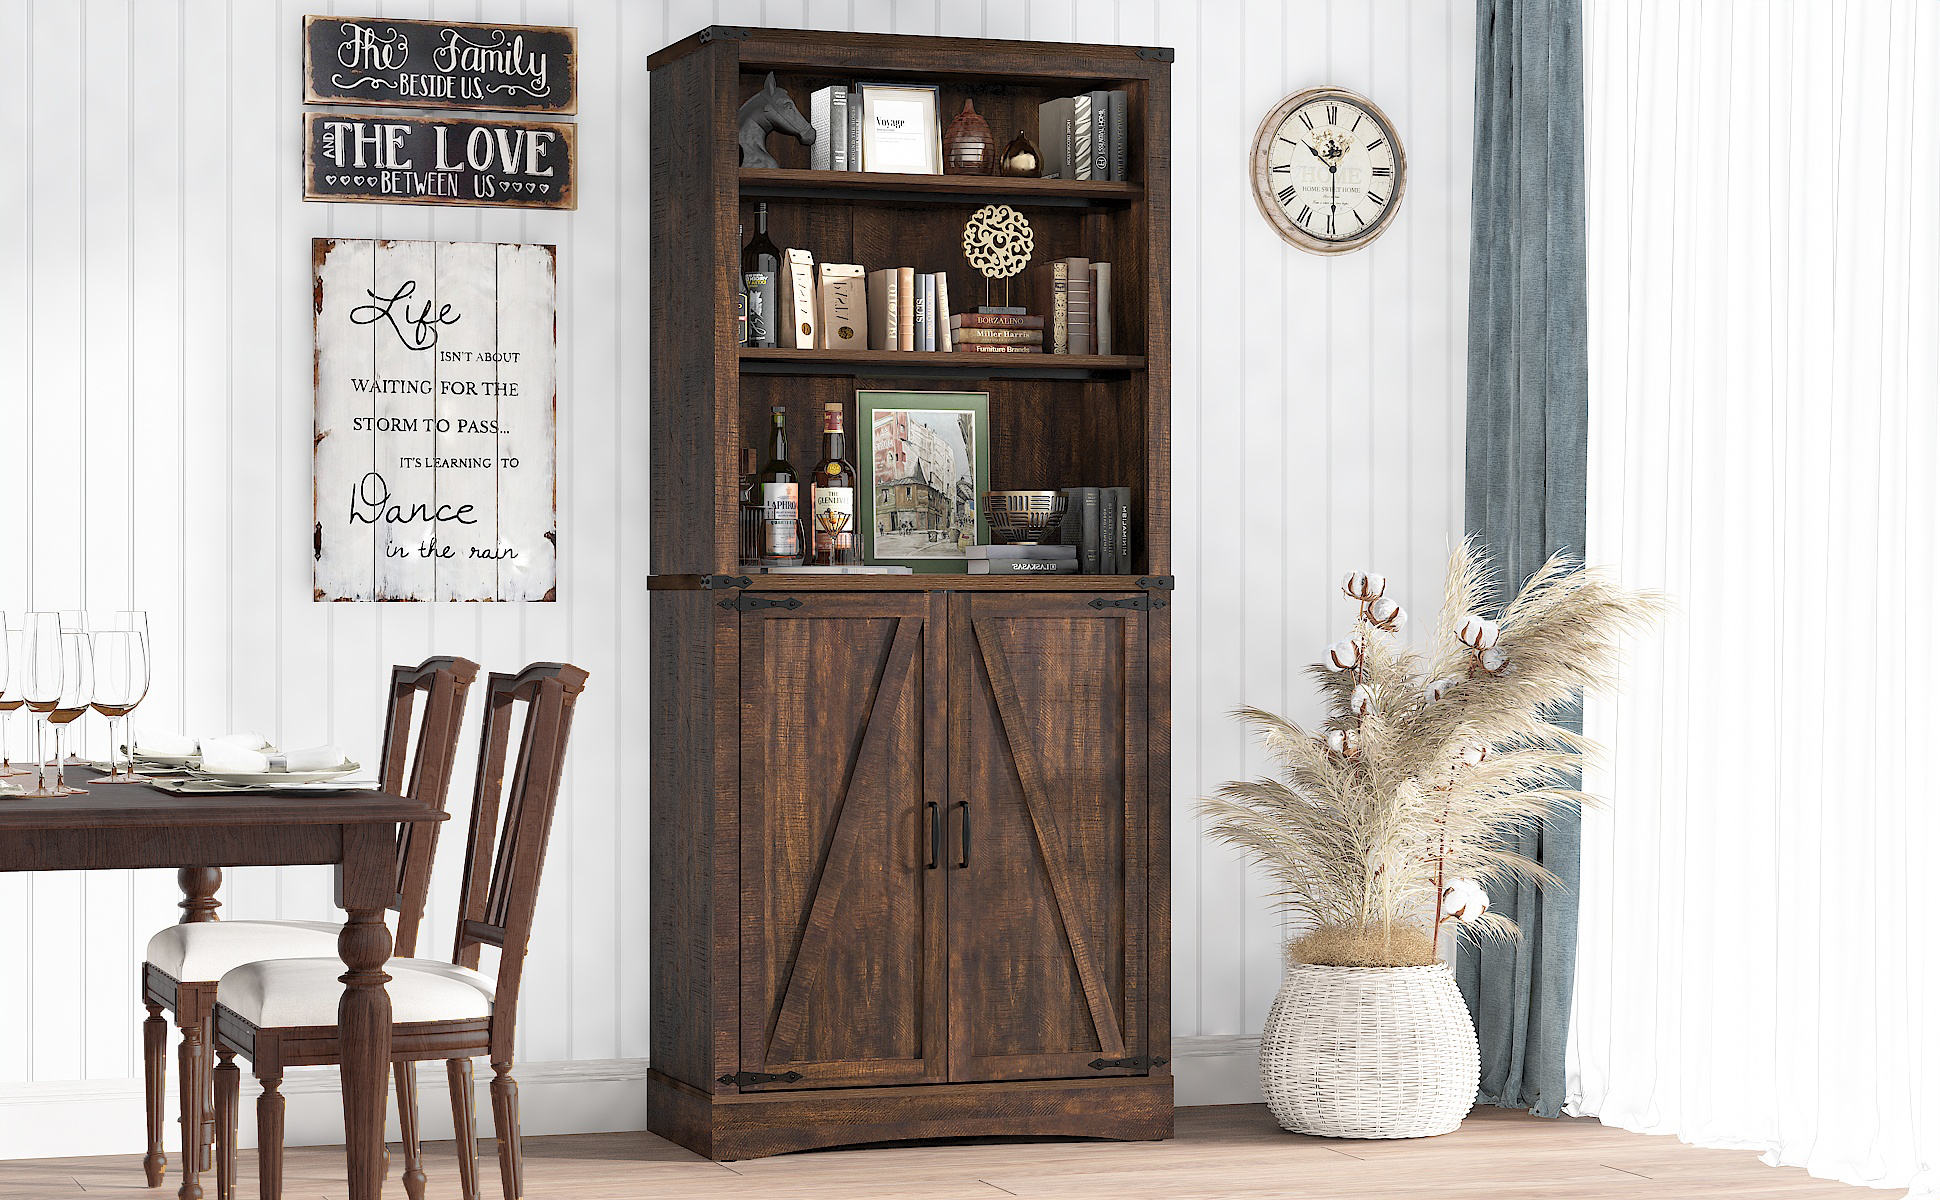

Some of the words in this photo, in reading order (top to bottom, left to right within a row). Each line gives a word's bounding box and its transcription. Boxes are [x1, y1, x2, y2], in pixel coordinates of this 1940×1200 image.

[338, 23, 409, 70] The
[433, 28, 547, 91] Family
[400, 74, 456, 98] BESIDE
[461, 75, 485, 100] US,
[876, 116, 906, 130] Voyage
[322, 132, 335, 159] AND
[324, 122, 412, 170] THE
[433, 126, 556, 177] LOVE
[381, 170, 459, 197] BETWEEN
[474, 174, 496, 198] US
[1300, 165, 1361, 184] HOME
[350, 280, 461, 351] Life
[976, 330, 1002, 338] Miller
[1003, 330, 1030, 338] Harris
[440, 351, 473, 363] ISN'T
[476, 352, 521, 363] ABOUT
[976, 345, 1005, 353] Furniture
[351, 378, 433, 394] WAITING
[441, 381, 478, 396] FOR
[482, 382, 519, 397] THE
[353, 417, 418, 432] STORM
[423, 419, 450, 433] TO
[457, 419, 510, 434] PASS...
[400, 457, 422, 468] IT'S
[425, 457, 492, 469] LEARNING
[501, 458, 520, 468] TO
[350, 472, 478, 524] Dance
[386, 540, 410, 558] in
[418, 537, 456, 558] the
[469, 543, 519, 560] rain
